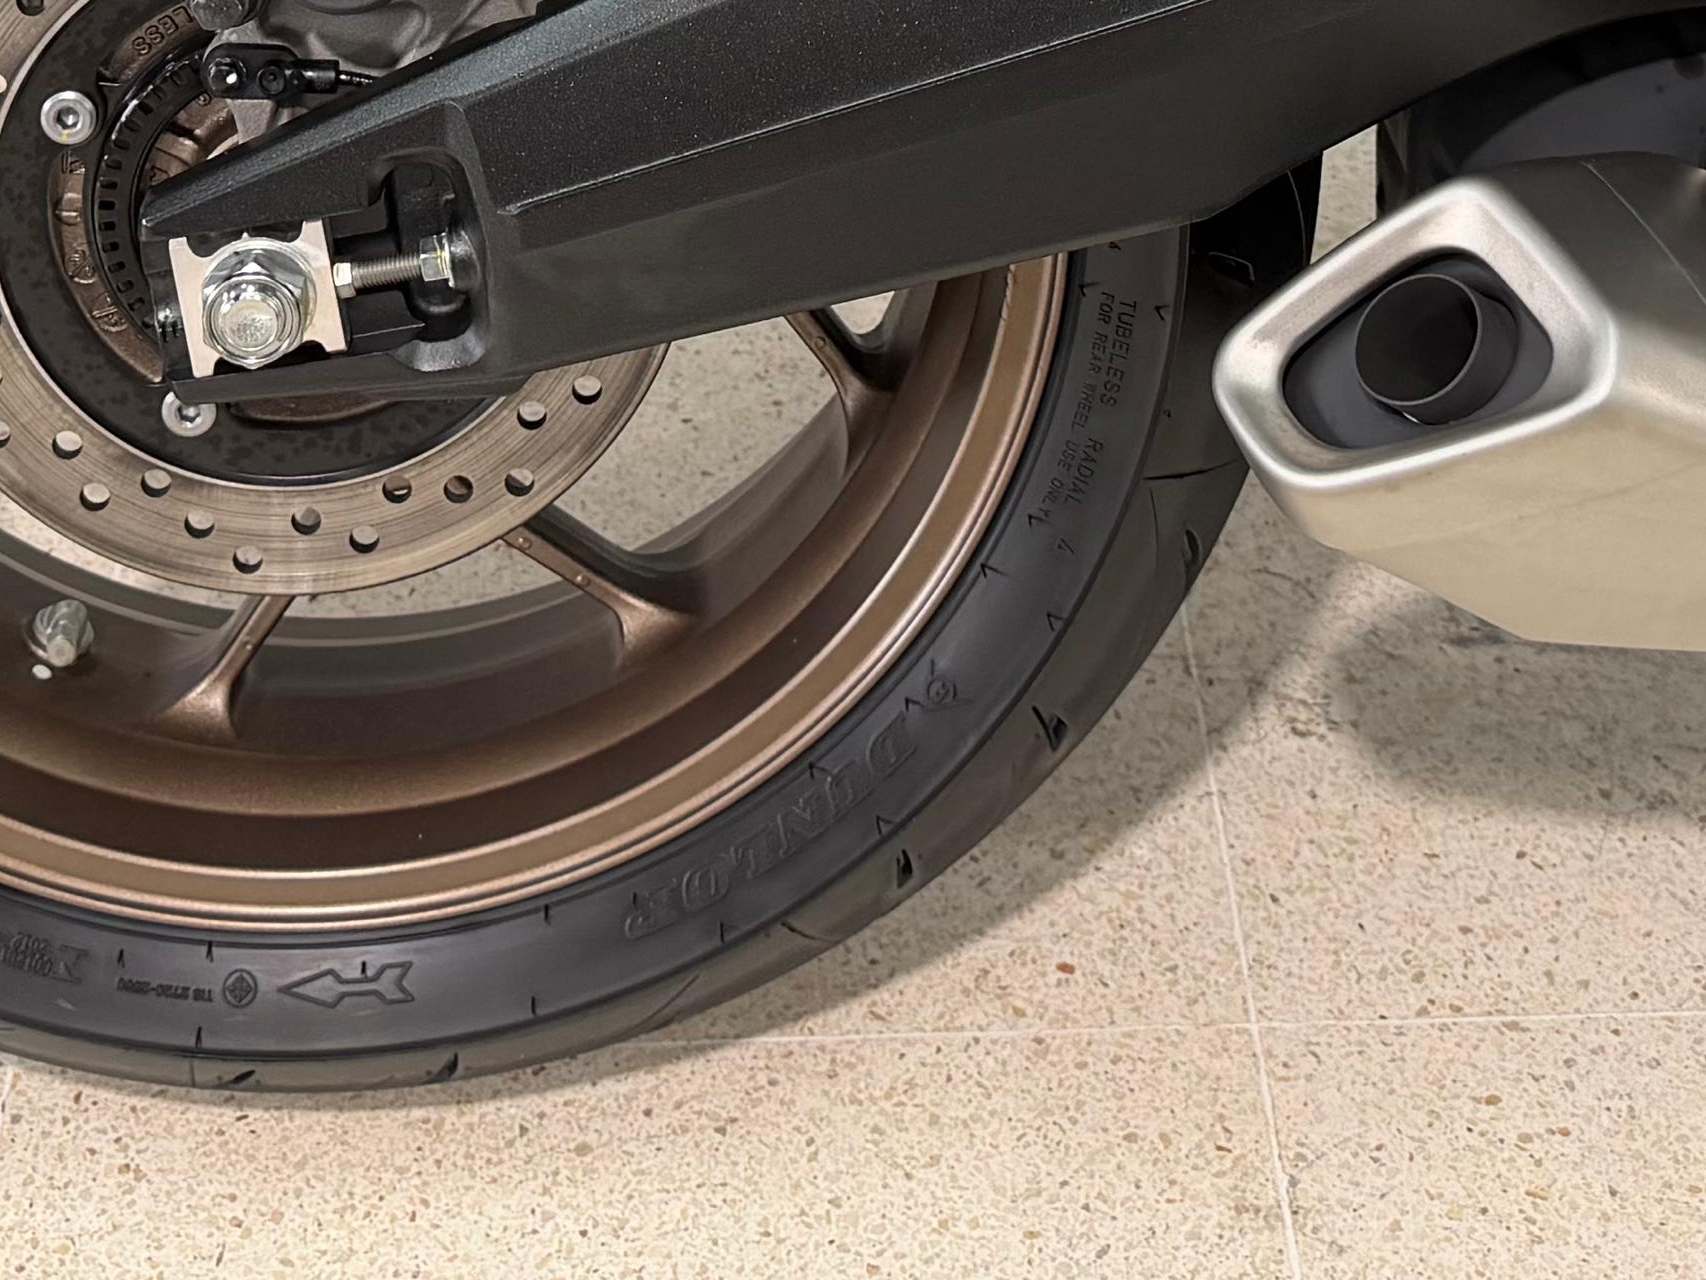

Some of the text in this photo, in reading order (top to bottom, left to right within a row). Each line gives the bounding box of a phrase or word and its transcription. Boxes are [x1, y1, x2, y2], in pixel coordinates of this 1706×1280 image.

[1064, 300, 1137, 507] TUBELESS RADIAL
[624, 709, 919, 942] DUNLOP
